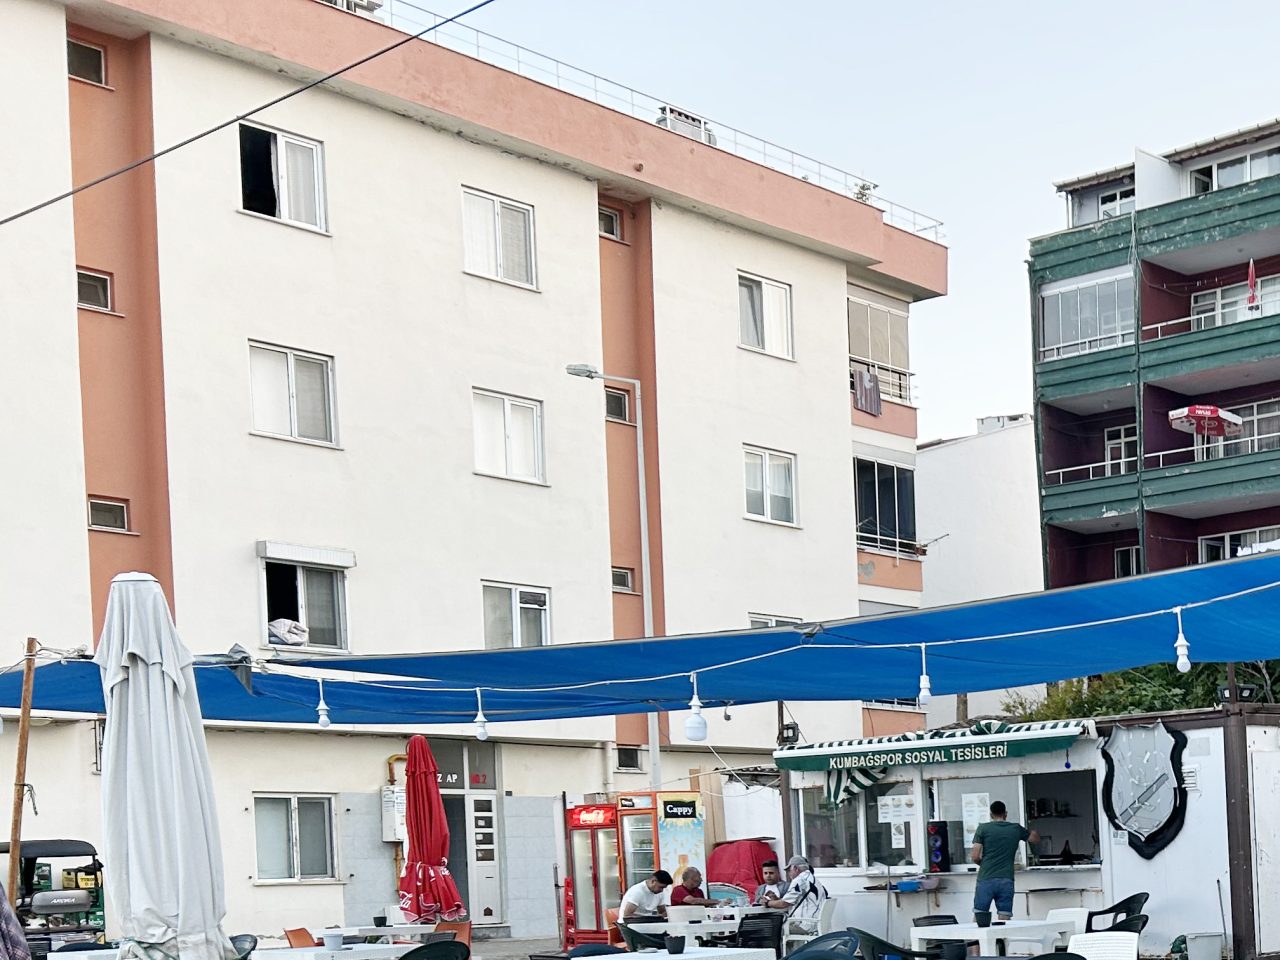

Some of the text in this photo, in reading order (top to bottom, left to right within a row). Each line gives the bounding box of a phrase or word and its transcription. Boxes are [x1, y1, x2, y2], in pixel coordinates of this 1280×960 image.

[829, 742, 1008, 769] KUMBAĞSPOR SOSYAL TESİSLERİ
[446, 773, 458, 783] AP
[666, 804, 693, 816] Cappy
